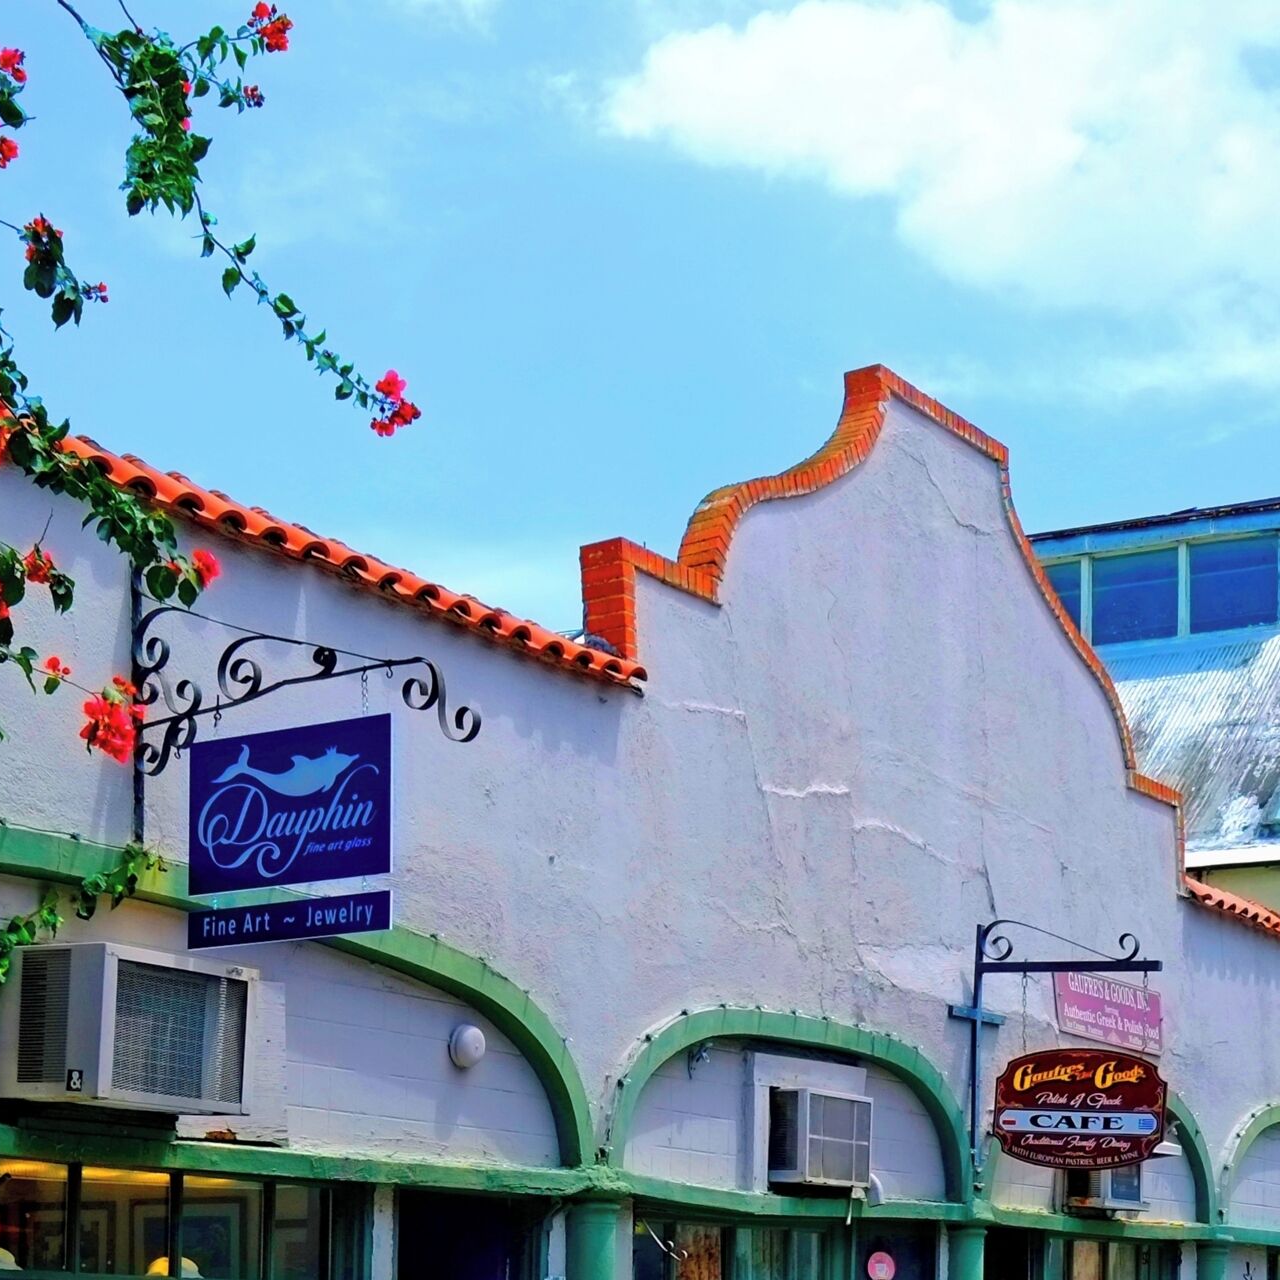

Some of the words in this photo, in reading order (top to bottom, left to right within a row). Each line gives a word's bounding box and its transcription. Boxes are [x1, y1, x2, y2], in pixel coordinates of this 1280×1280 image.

[198, 764, 379, 878] Dauphin
[303, 842, 325, 856] fine
[327, 840, 343, 852] art
[344, 836, 373, 852] glass
[203, 916, 237, 937] Fine
[243, 912, 270, 934] Art
[306, 900, 374, 927] Jewelry
[1068, 971, 1105, 1000] GAUFRES
[1104, 980, 1111, 1001] &
[1063, 1002, 1097, 1024] Authentic
[1096, 1011, 1117, 1029] Greek
[1124, 1018, 1144, 1037] Polish
[1013, 1061, 1085, 1091] Gaufres
[1094, 1060, 1146, 1090] Goods
[1035, 1091, 1068, 1105] Polish
[1086, 1092, 1122, 1109] Greek
[1029, 1114, 1124, 1131] CAFE
[1011, 1145, 1030, 1158] WITH
[1029, 1150, 1064, 1165] EUROPEAN
[1096, 1156, 1113, 1165] BEER
[1120, 1150, 1139, 1161] WINE
[1020, 1133, 1067, 1146] Traditional
[1067, 1134, 1097, 1151] Family
[1099, 1136, 1131, 1152] Dining
